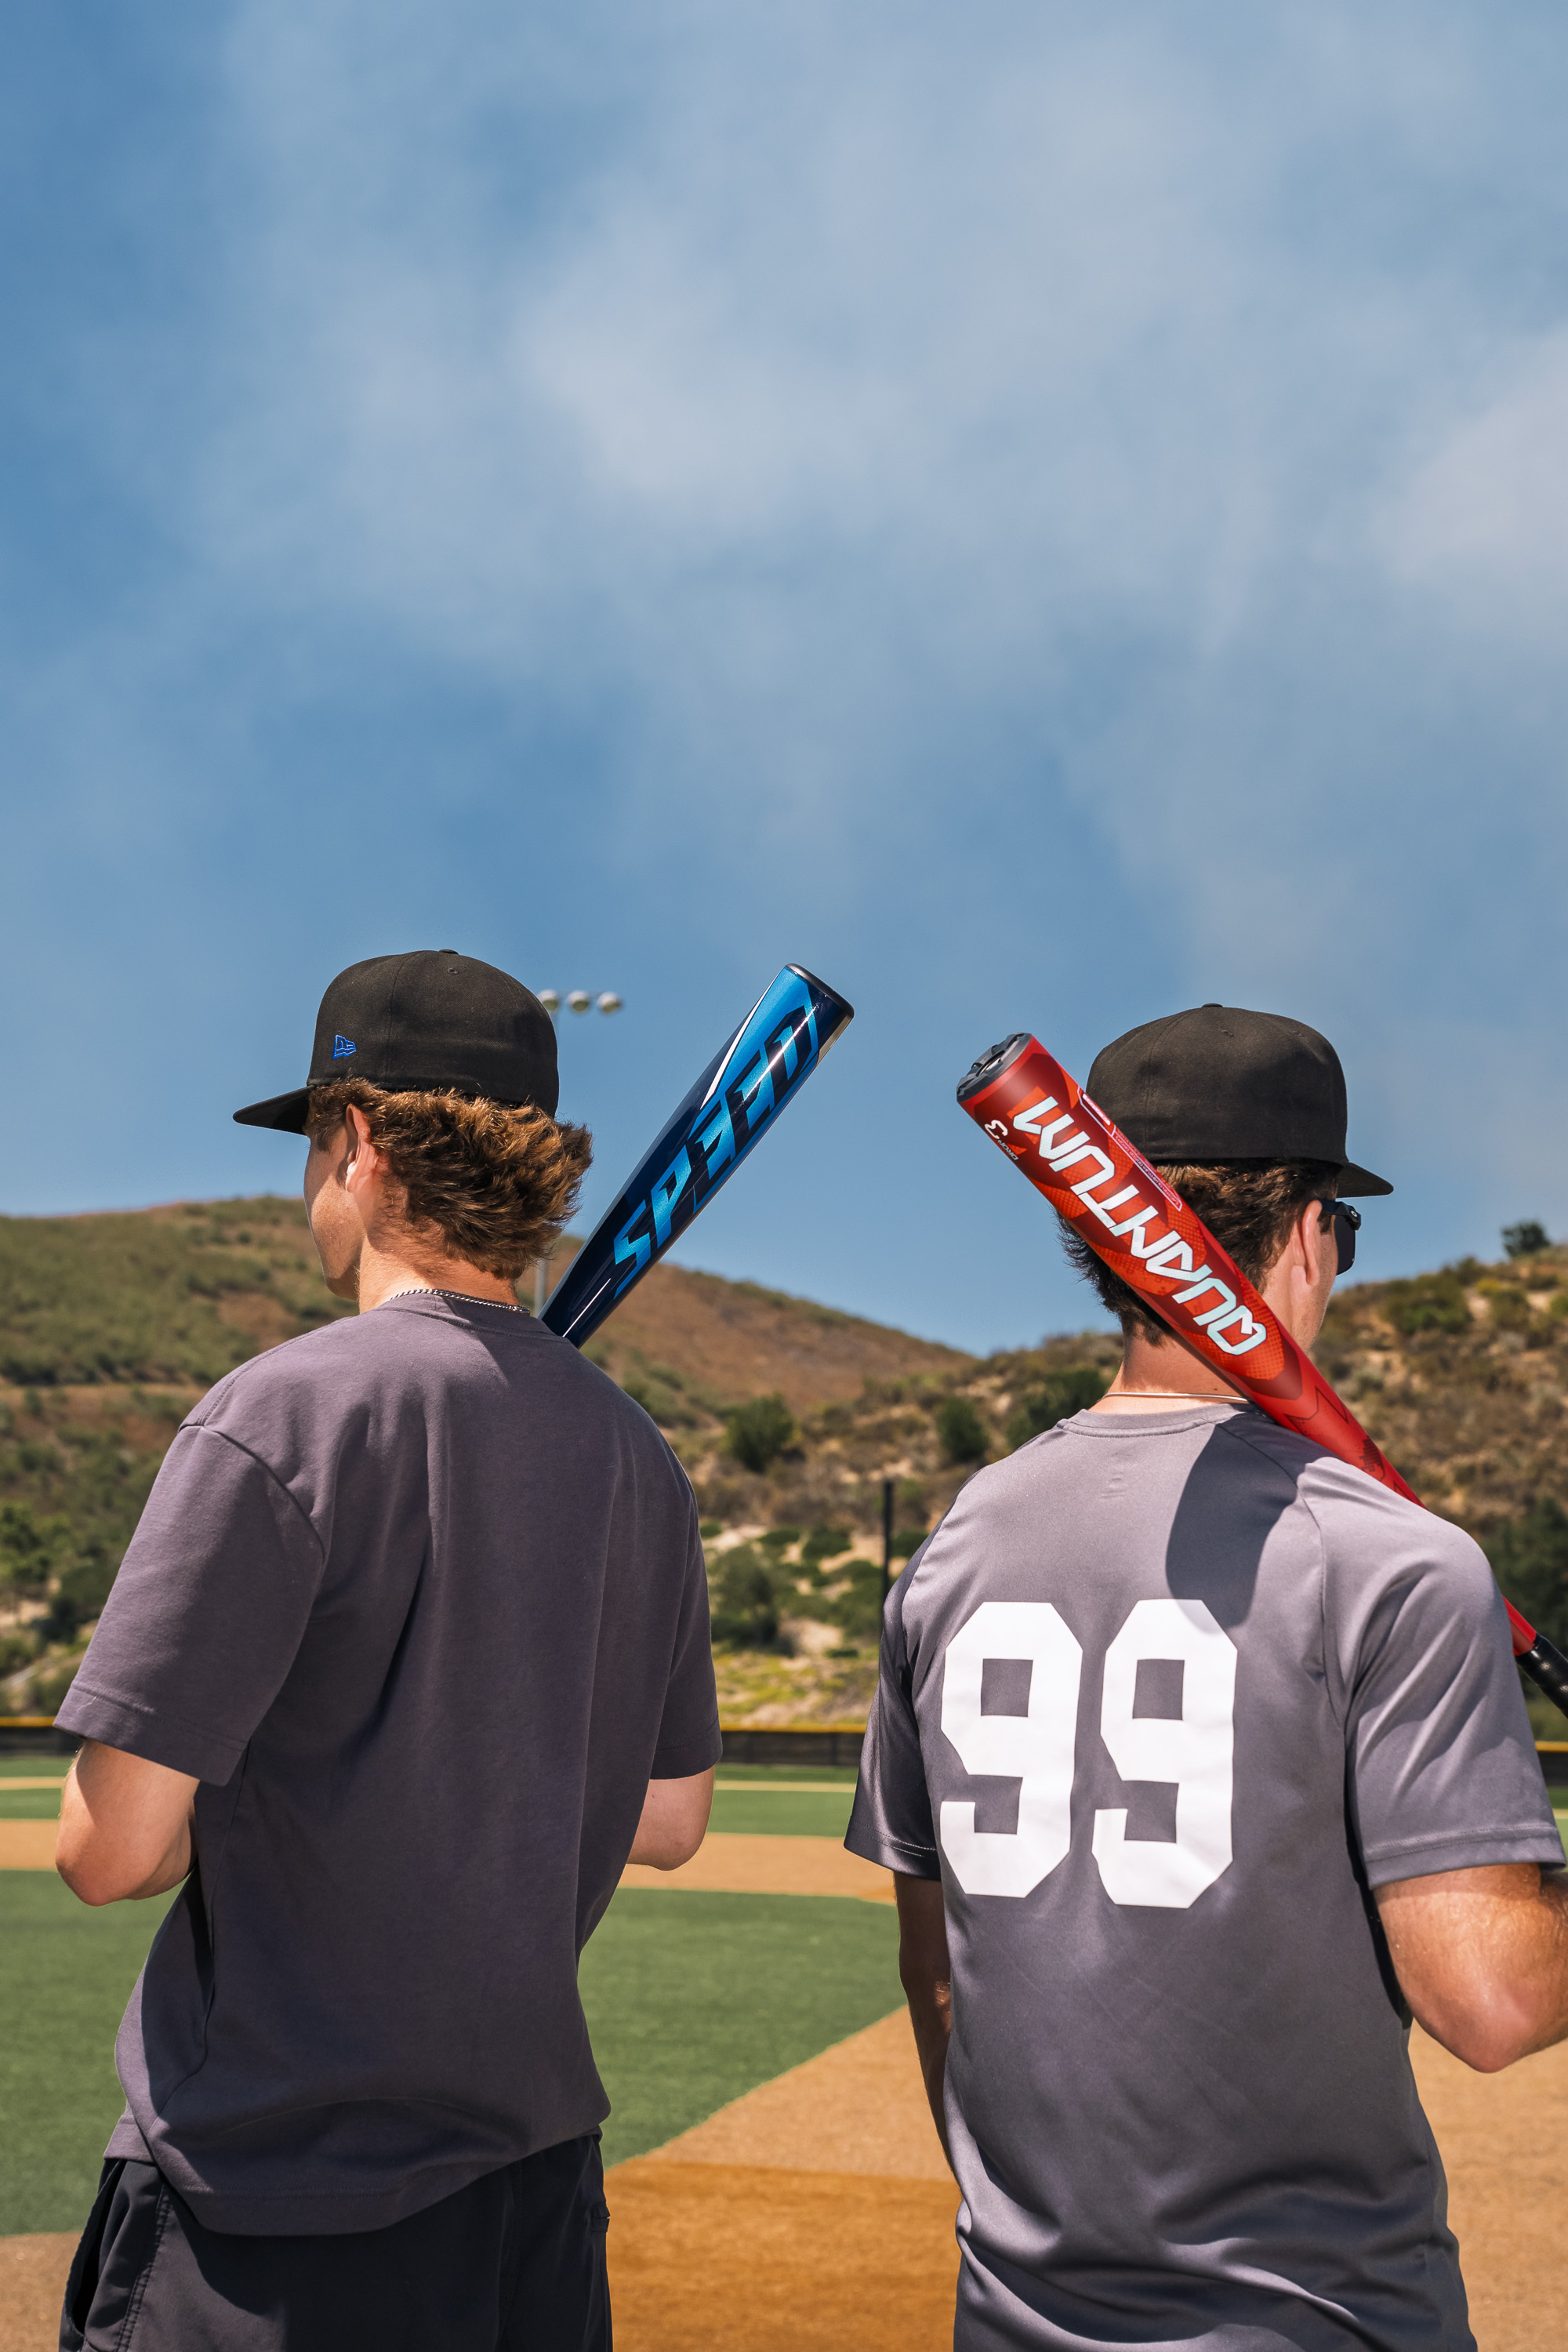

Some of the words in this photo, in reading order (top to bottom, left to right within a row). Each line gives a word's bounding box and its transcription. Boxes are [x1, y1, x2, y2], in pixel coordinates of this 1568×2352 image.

[614, 1005, 817, 1298] SPEED
[985, 1120, 1008, 1140] 3
[997, 1139, 1018, 1160] DROP
[1013, 1096, 1266, 1355] QUANTUM
[940, 1599, 1238, 1909] 99
